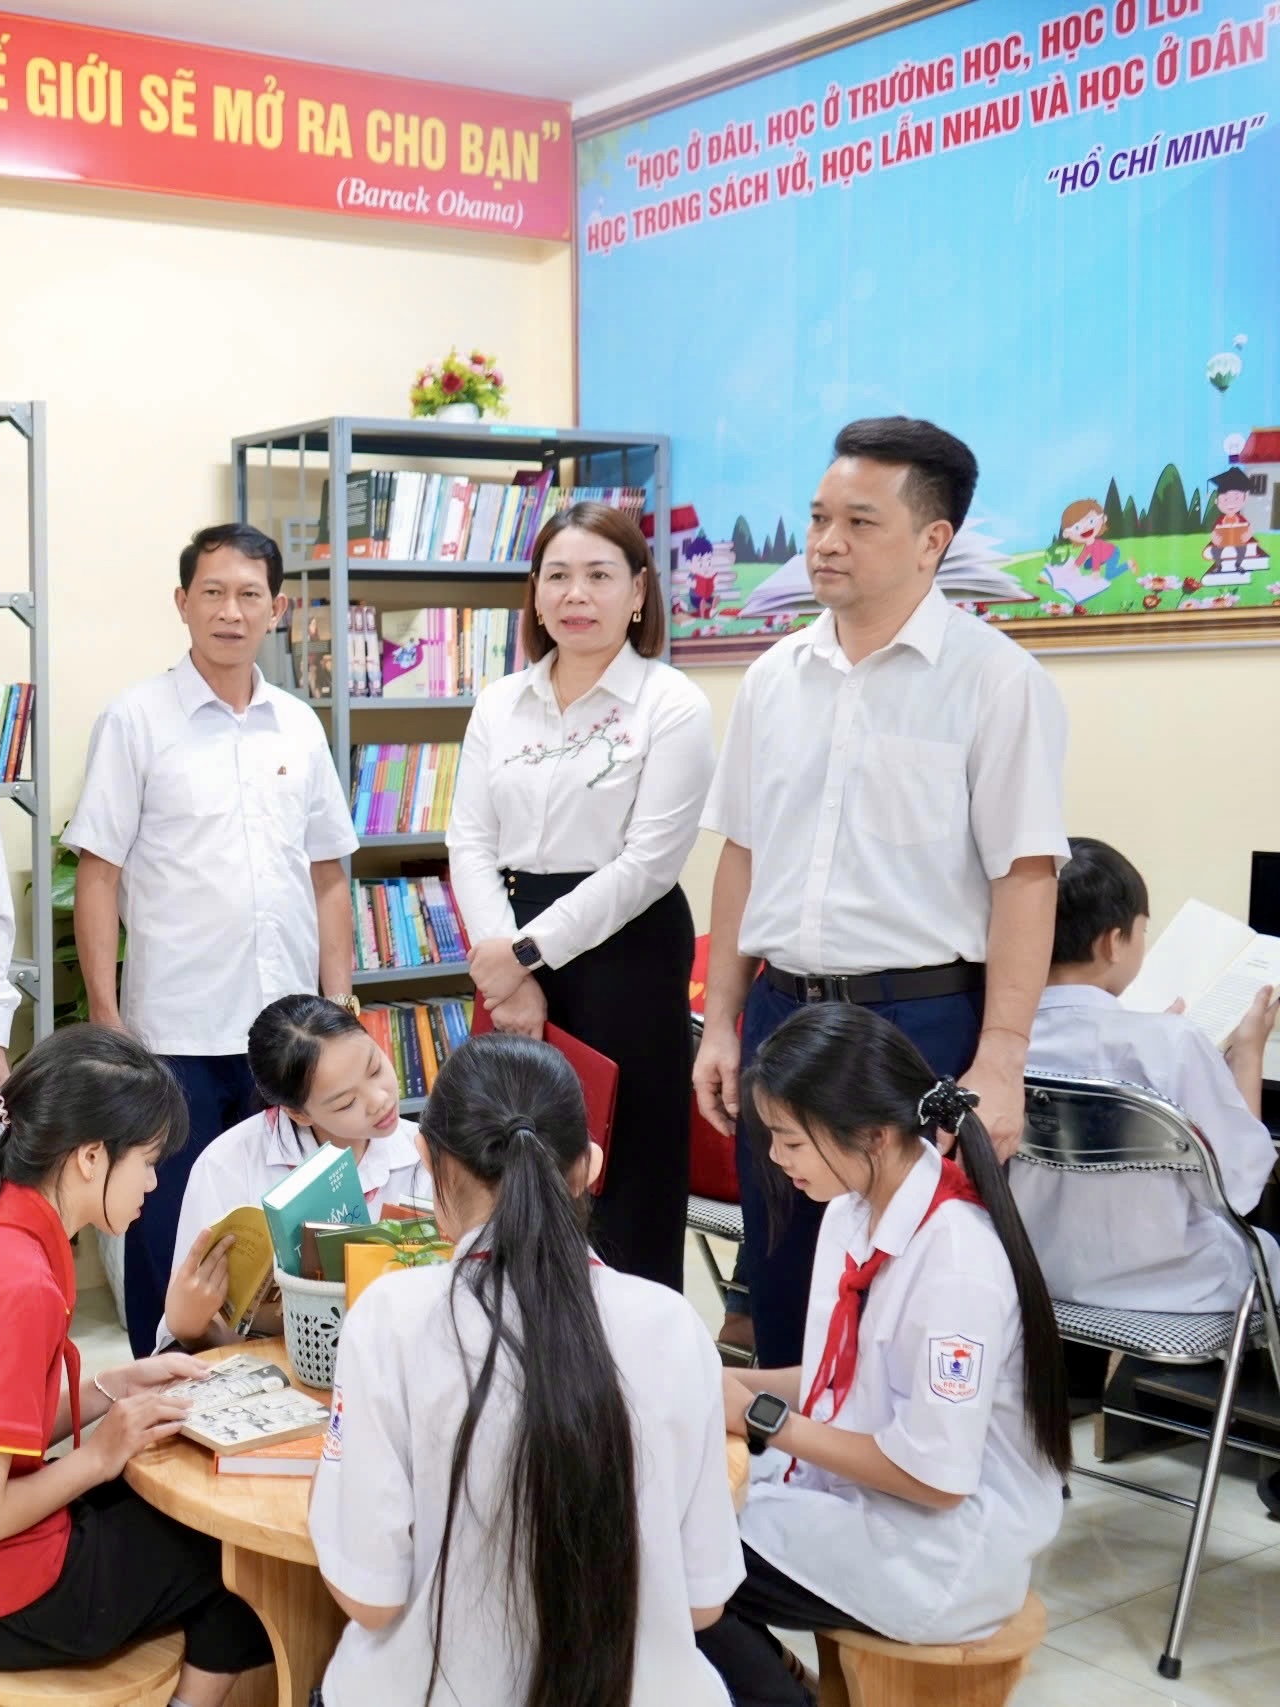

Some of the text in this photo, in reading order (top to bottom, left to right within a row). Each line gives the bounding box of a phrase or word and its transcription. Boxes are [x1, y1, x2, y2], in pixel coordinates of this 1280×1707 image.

[25, 53, 124, 127] GIỚI
[139, 69, 199, 137] SẼ
[213, 75, 287, 150] MỞ
[297, 99, 353, 160] RA
[365, 109, 447, 171] CHO
[587, 216, 626, 253] HỌC
[633, 193, 701, 236] TRONG
[709, 174, 769, 217] SÁCH
[776, 151, 813, 196] VỞ,
[822, 140, 873, 187] HỌC
[881, 112, 934, 167] LẪN
[942, 95, 1021, 149] NHAU
[1030, 76, 1070, 123] VÀ
[1079, 58, 1145, 110] HỌC
[1157, 36, 1180, 86] Ở
[686, 133, 702, 171] Ở
[708, 123, 760, 166] ĐÂU,
[768, 104, 816, 148] HỌC
[823, 86, 840, 127] Ở
[848, 57, 954, 119] TRƯỜNG
[964, 36, 1031, 86] HỌC,
[1041, 9, 1105, 59] HỌC
[337, 178, 523, 228] (Barack Obama)
[1109, 135, 1160, 181] CHÍ
